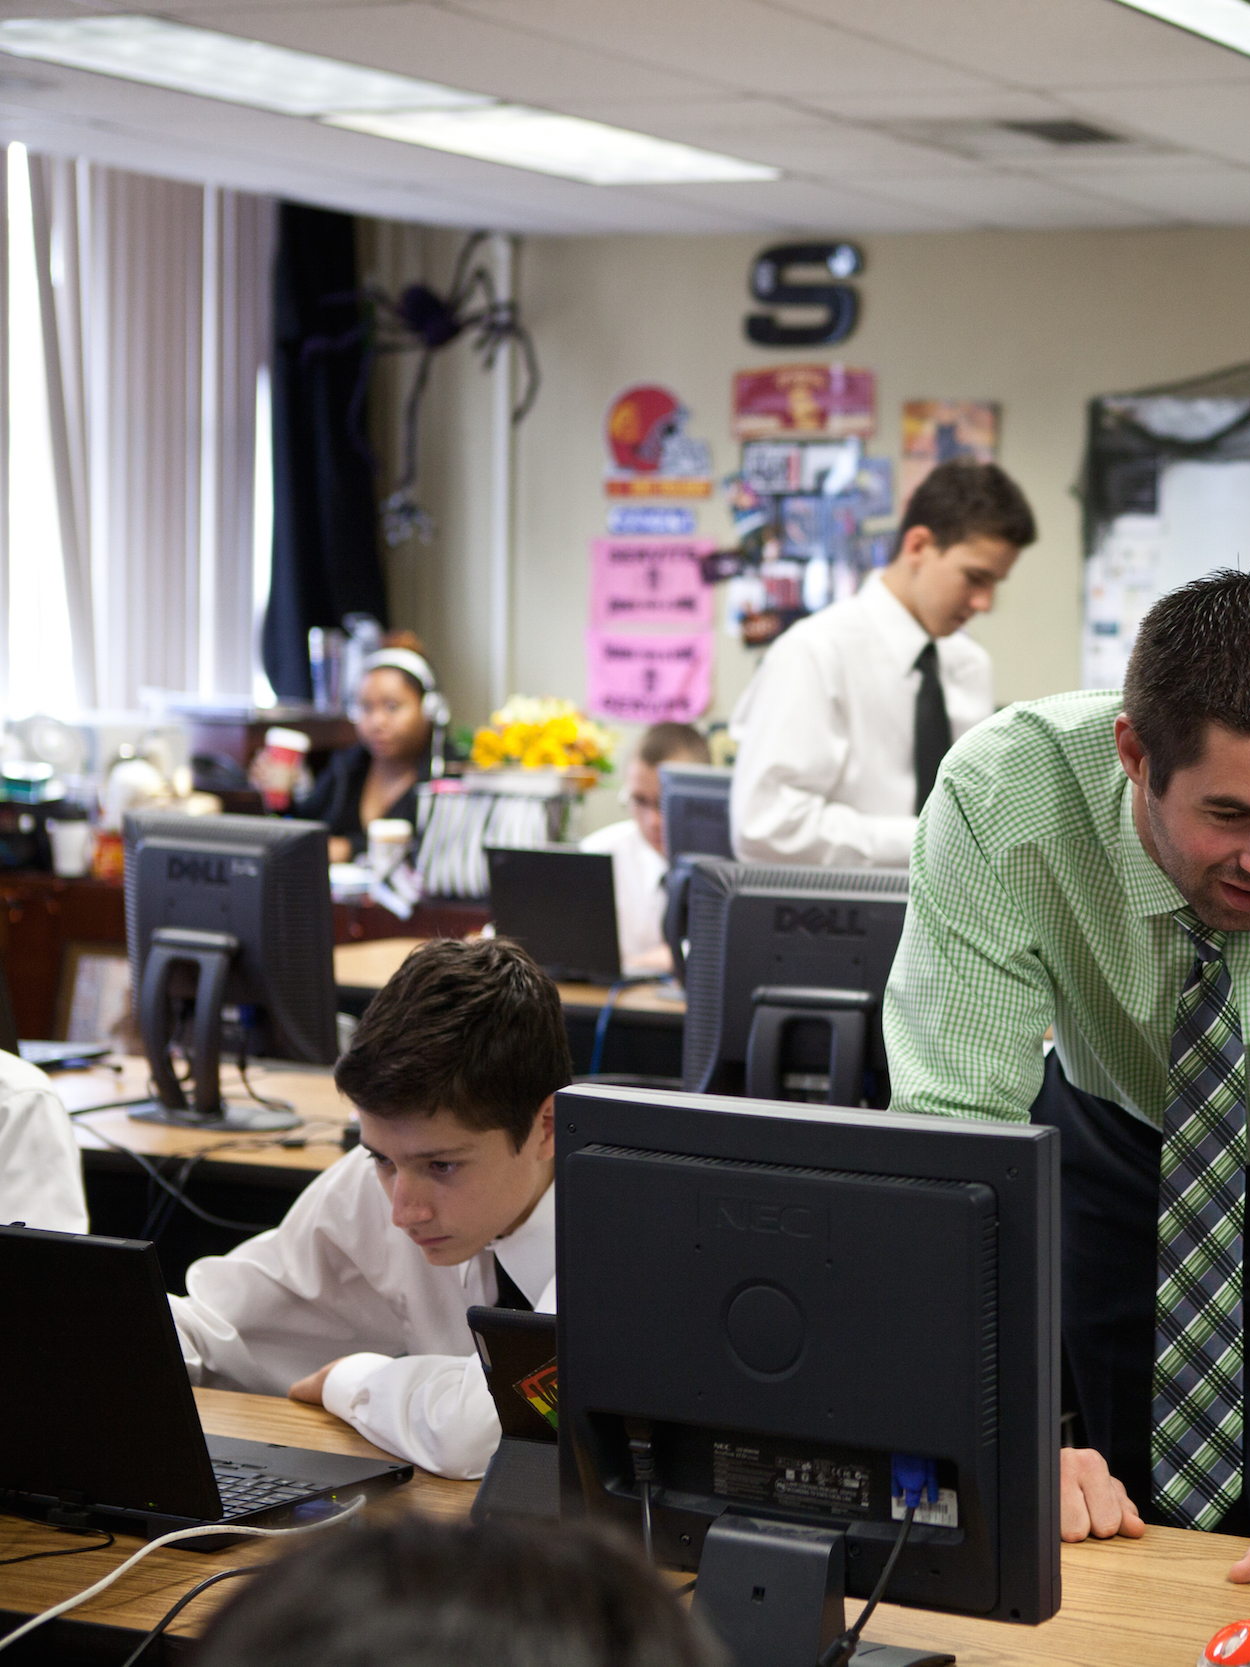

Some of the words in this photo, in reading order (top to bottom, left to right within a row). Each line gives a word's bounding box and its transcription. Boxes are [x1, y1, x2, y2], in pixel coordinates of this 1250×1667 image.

[746, 243, 863, 346] S
[169, 857, 229, 885] DELL
[776, 906, 865, 935] DELL
[718, 1202, 812, 1238] NEC
